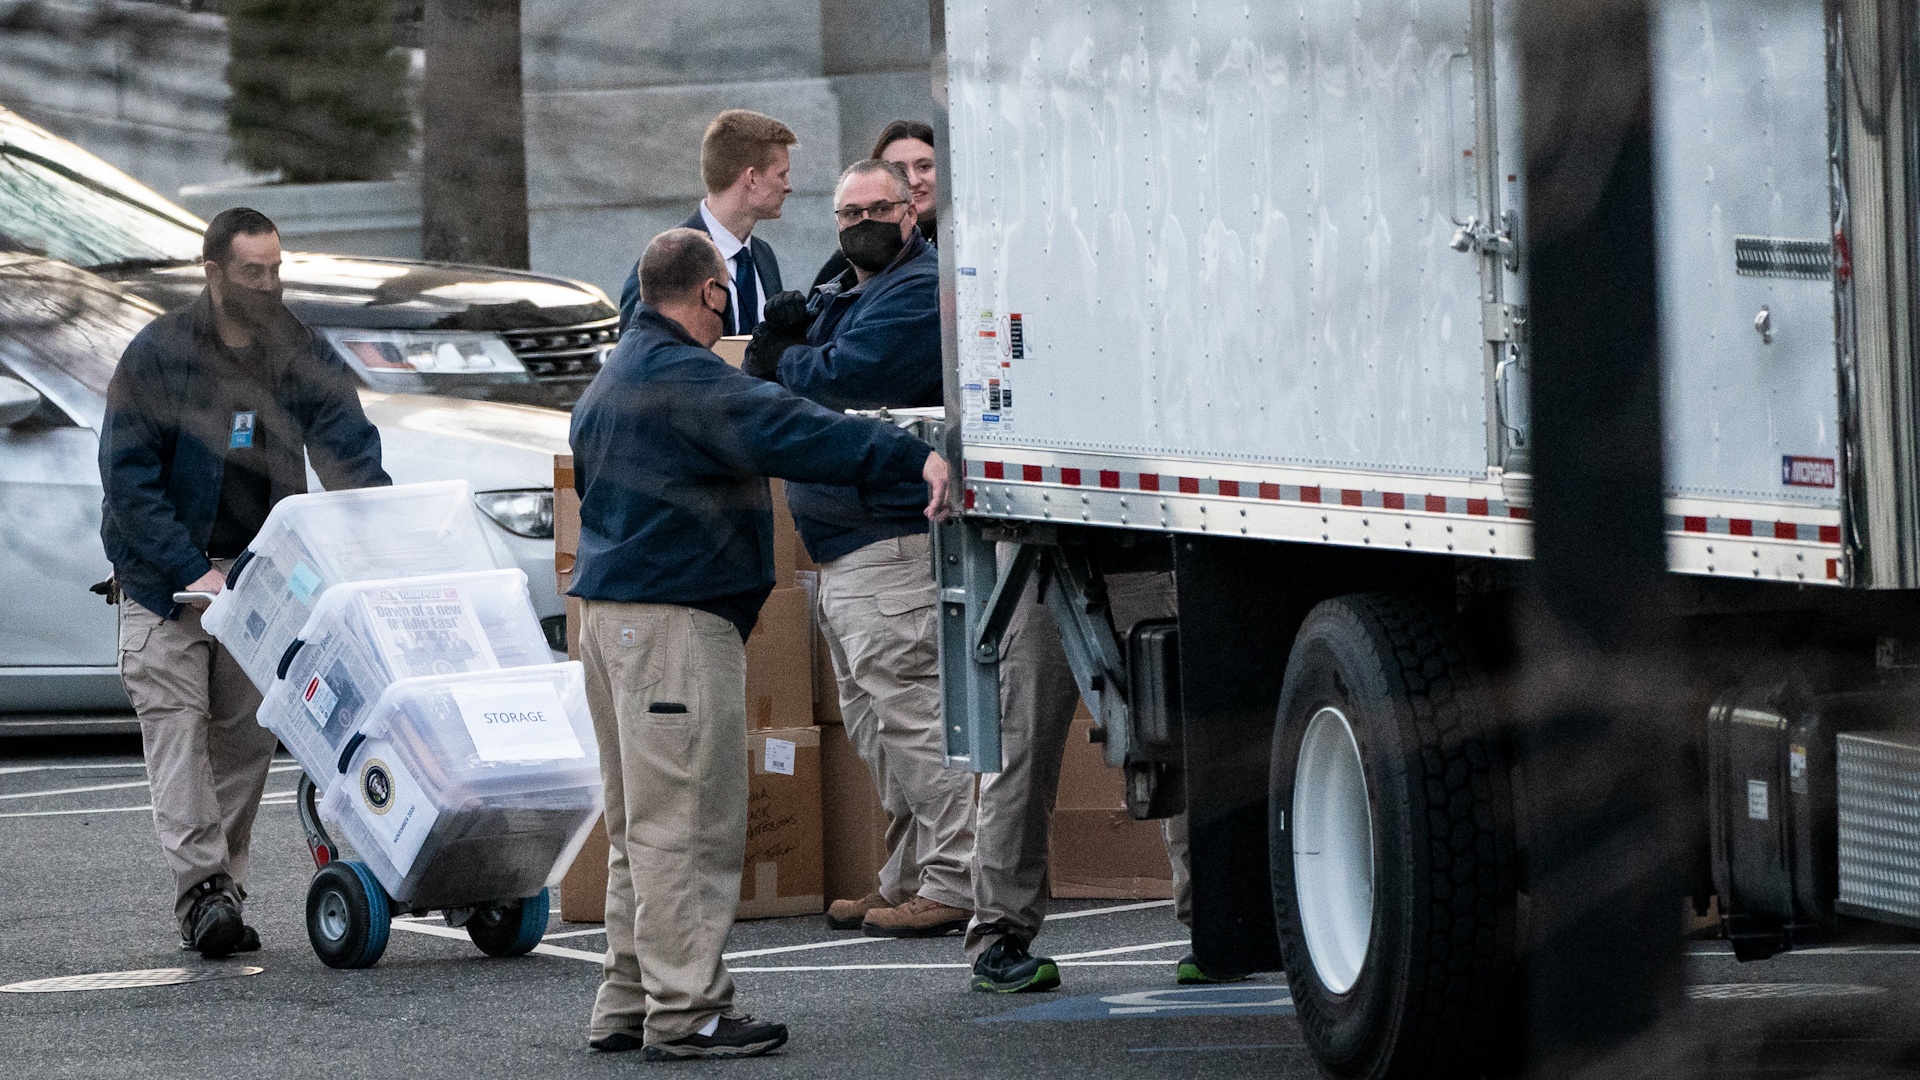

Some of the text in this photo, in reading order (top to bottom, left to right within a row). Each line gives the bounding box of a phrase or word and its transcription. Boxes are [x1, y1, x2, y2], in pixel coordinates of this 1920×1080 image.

[1792, 461, 1833, 484] MORGAN
[421, 589, 441, 600] POST
[411, 604, 426, 616] of
[426, 605, 435, 616] a
[436, 604, 462, 616] new
[319, 630, 333, 652] Post
[483, 711, 547, 724] STORAGE
[393, 804, 416, 843] NOVEMBER 2020
